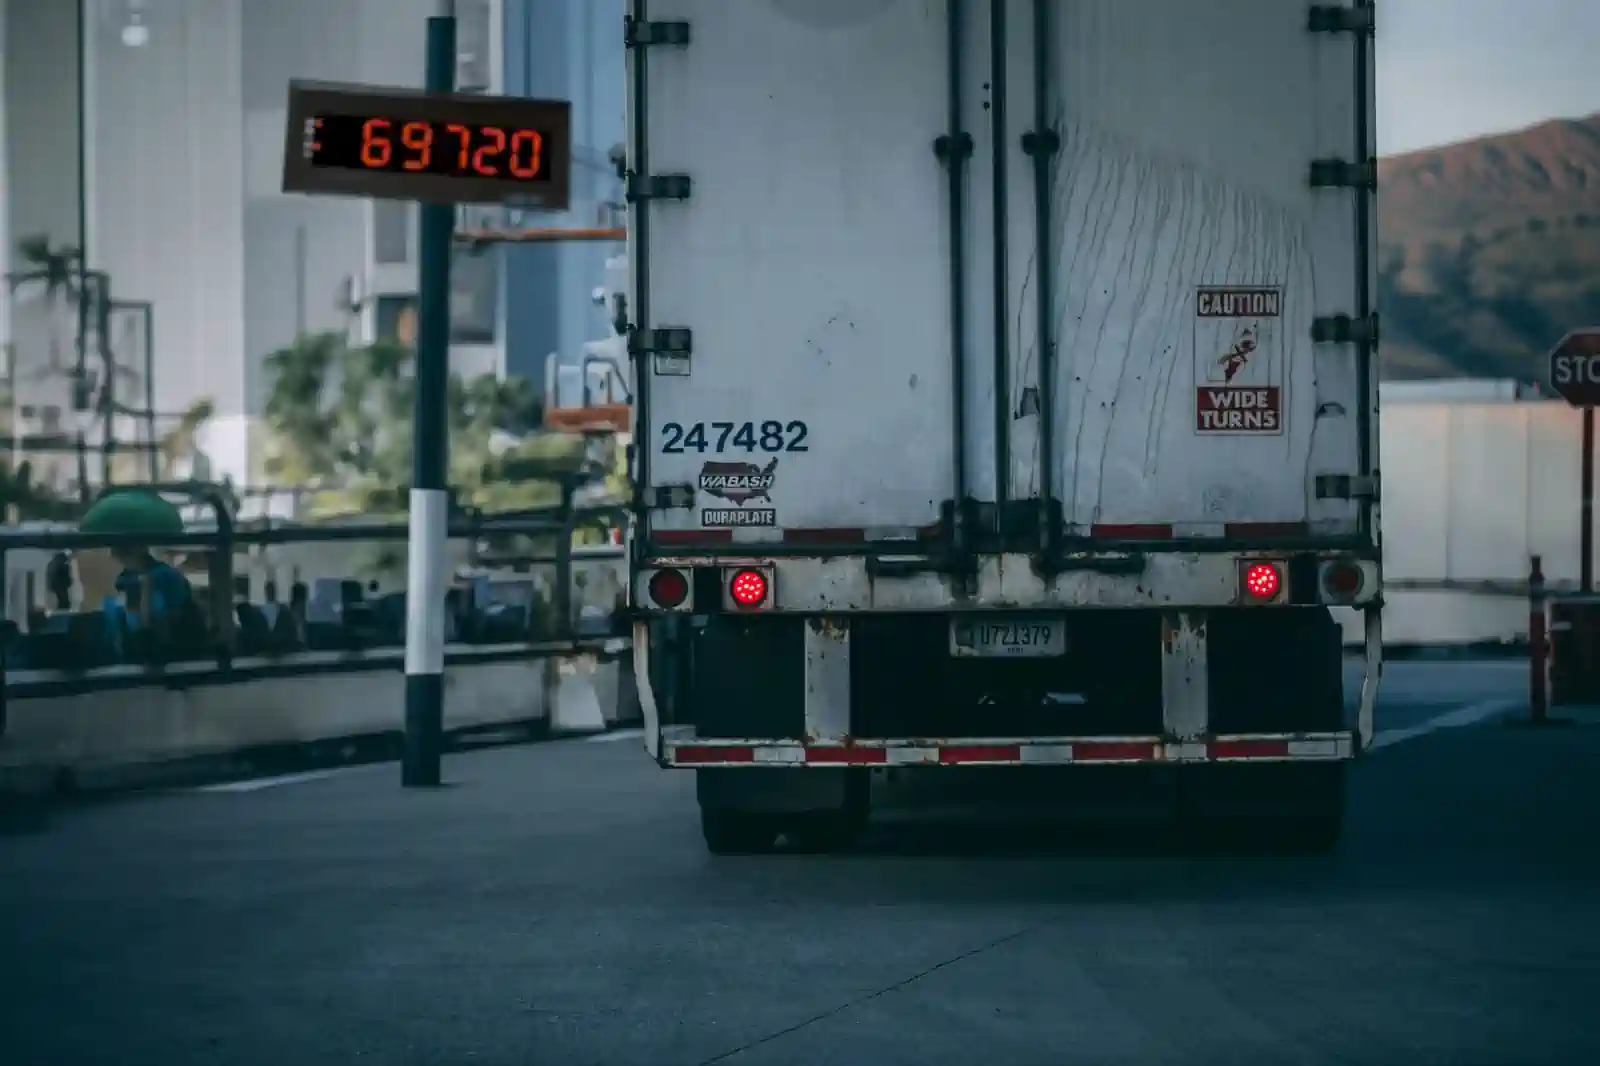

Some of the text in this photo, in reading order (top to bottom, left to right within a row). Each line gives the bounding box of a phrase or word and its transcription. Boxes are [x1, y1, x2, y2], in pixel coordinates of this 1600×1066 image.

[360, 118, 542, 178] 69720
[1200, 293, 1277, 314] CAUTION
[1208, 391, 1268, 409] WIDE
[1201, 410, 1277, 428] TURNS
[661, 420, 809, 453] 247482
[701, 475, 773, 488] WABASH
[704, 510, 773, 525] DURAPLATE
